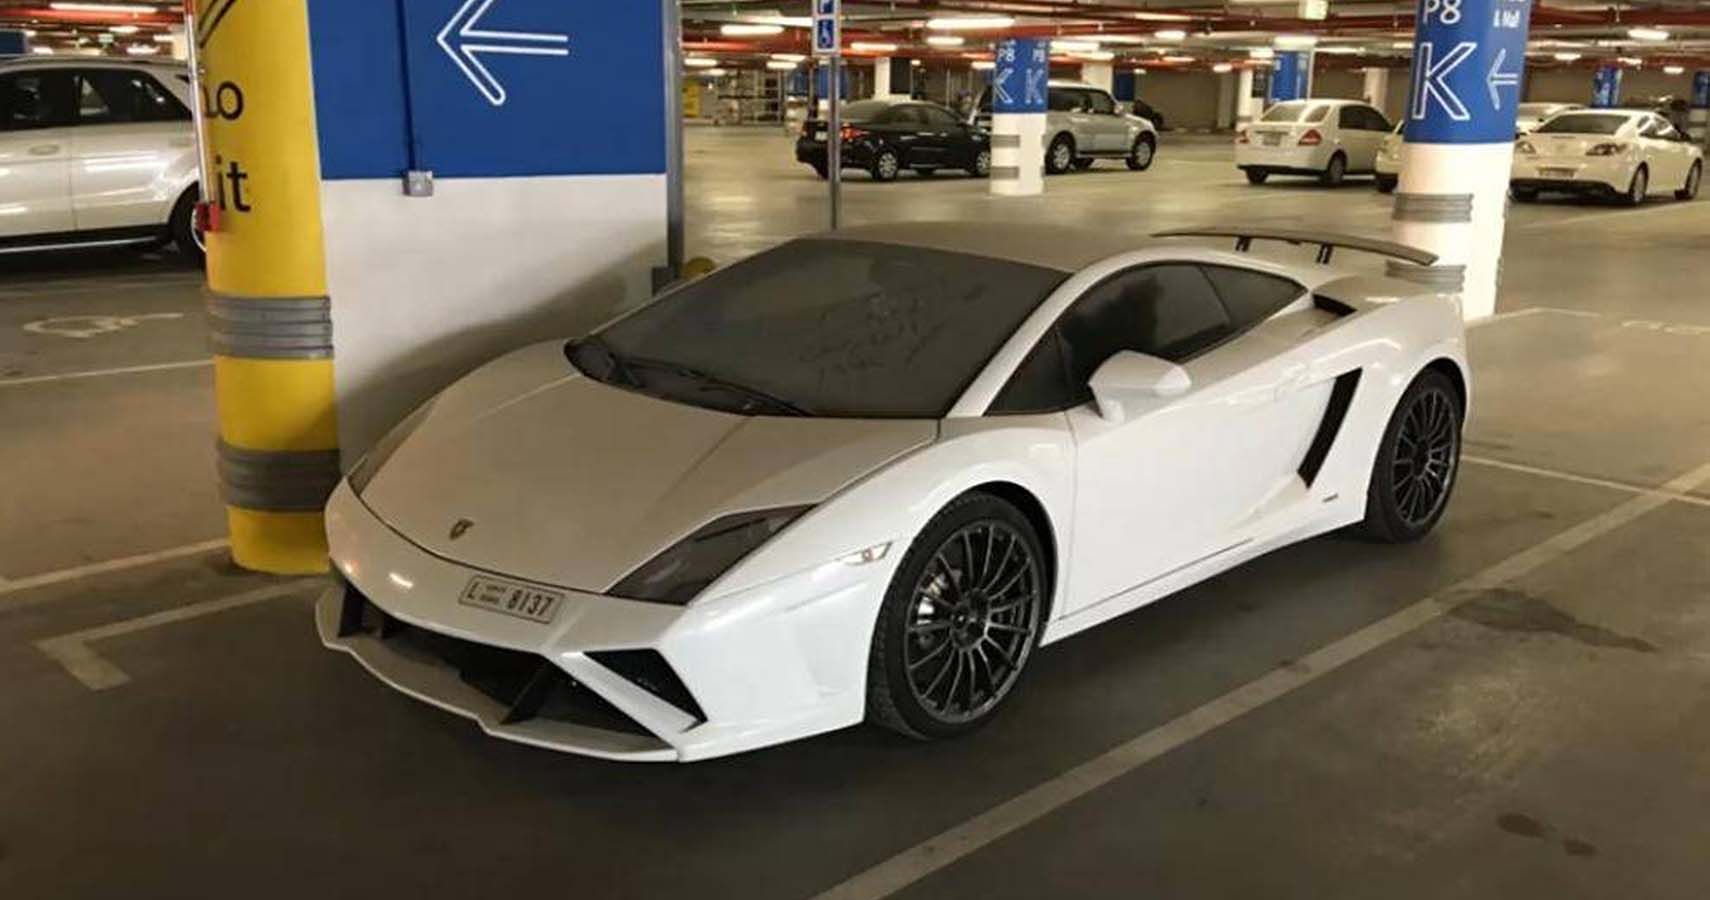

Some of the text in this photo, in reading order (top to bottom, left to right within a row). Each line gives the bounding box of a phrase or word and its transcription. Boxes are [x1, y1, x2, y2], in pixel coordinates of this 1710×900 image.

[1423, 0, 1462, 25] P8
[1025, 68, 1044, 104] K
[1411, 41, 1477, 121] K
[507, 589, 555, 616] 8137
